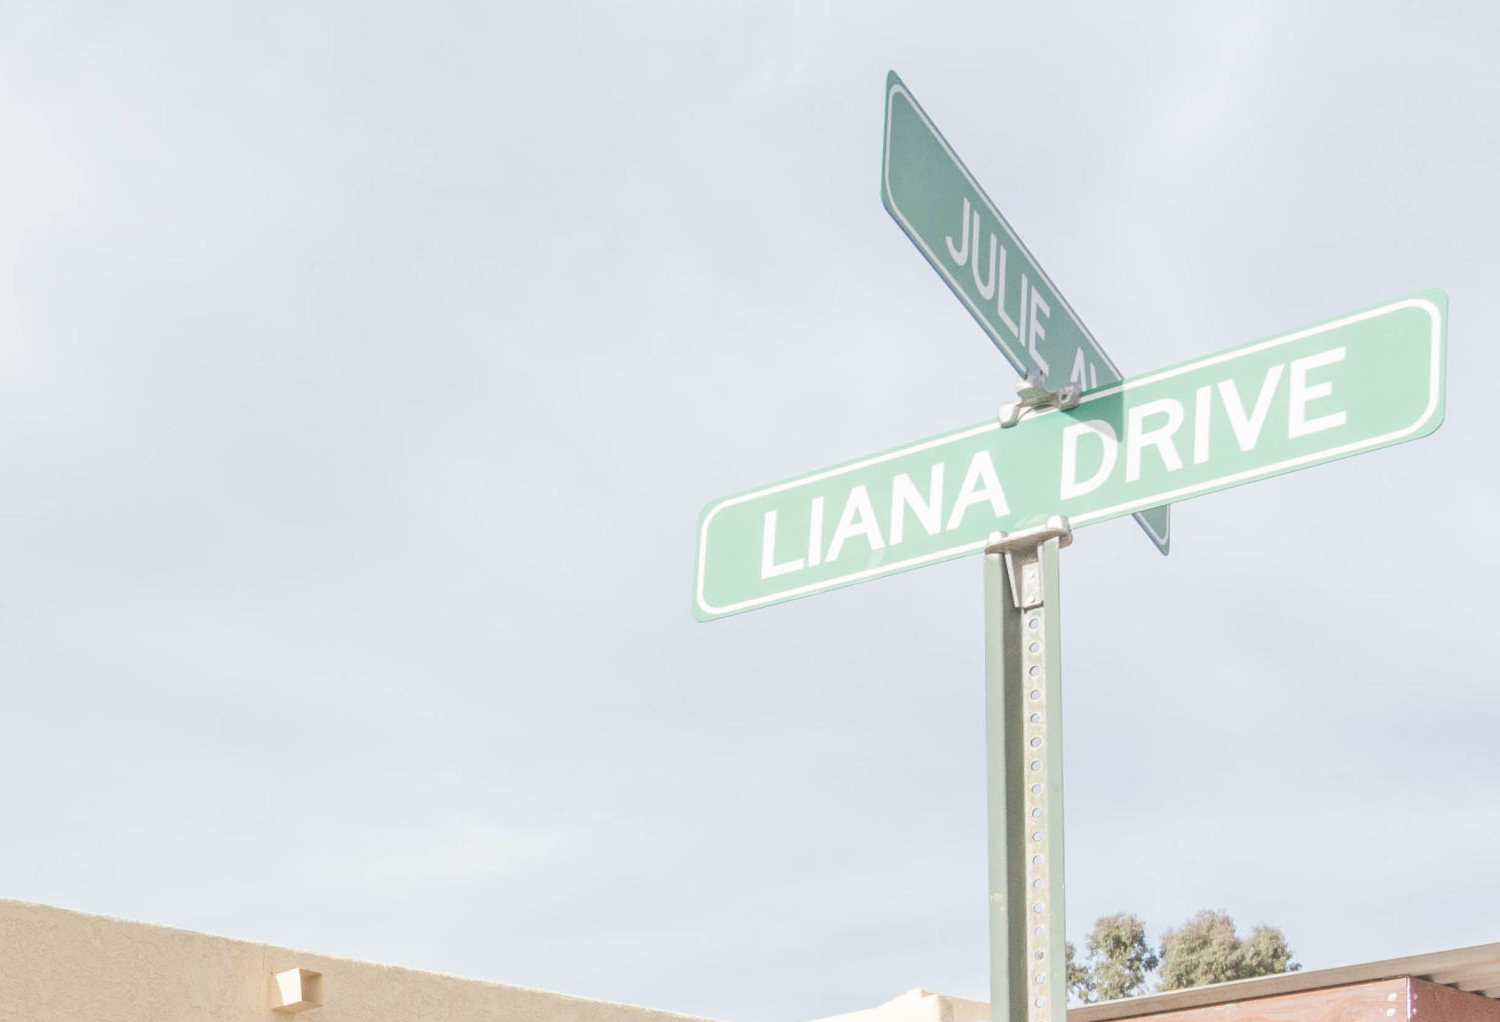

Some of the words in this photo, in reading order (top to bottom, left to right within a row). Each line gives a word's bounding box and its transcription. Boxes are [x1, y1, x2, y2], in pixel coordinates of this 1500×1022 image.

[946, 197, 1050, 376] JULIE
[760, 452, 1008, 579] LIANA
[1060, 347, 1347, 501] DRIVE
